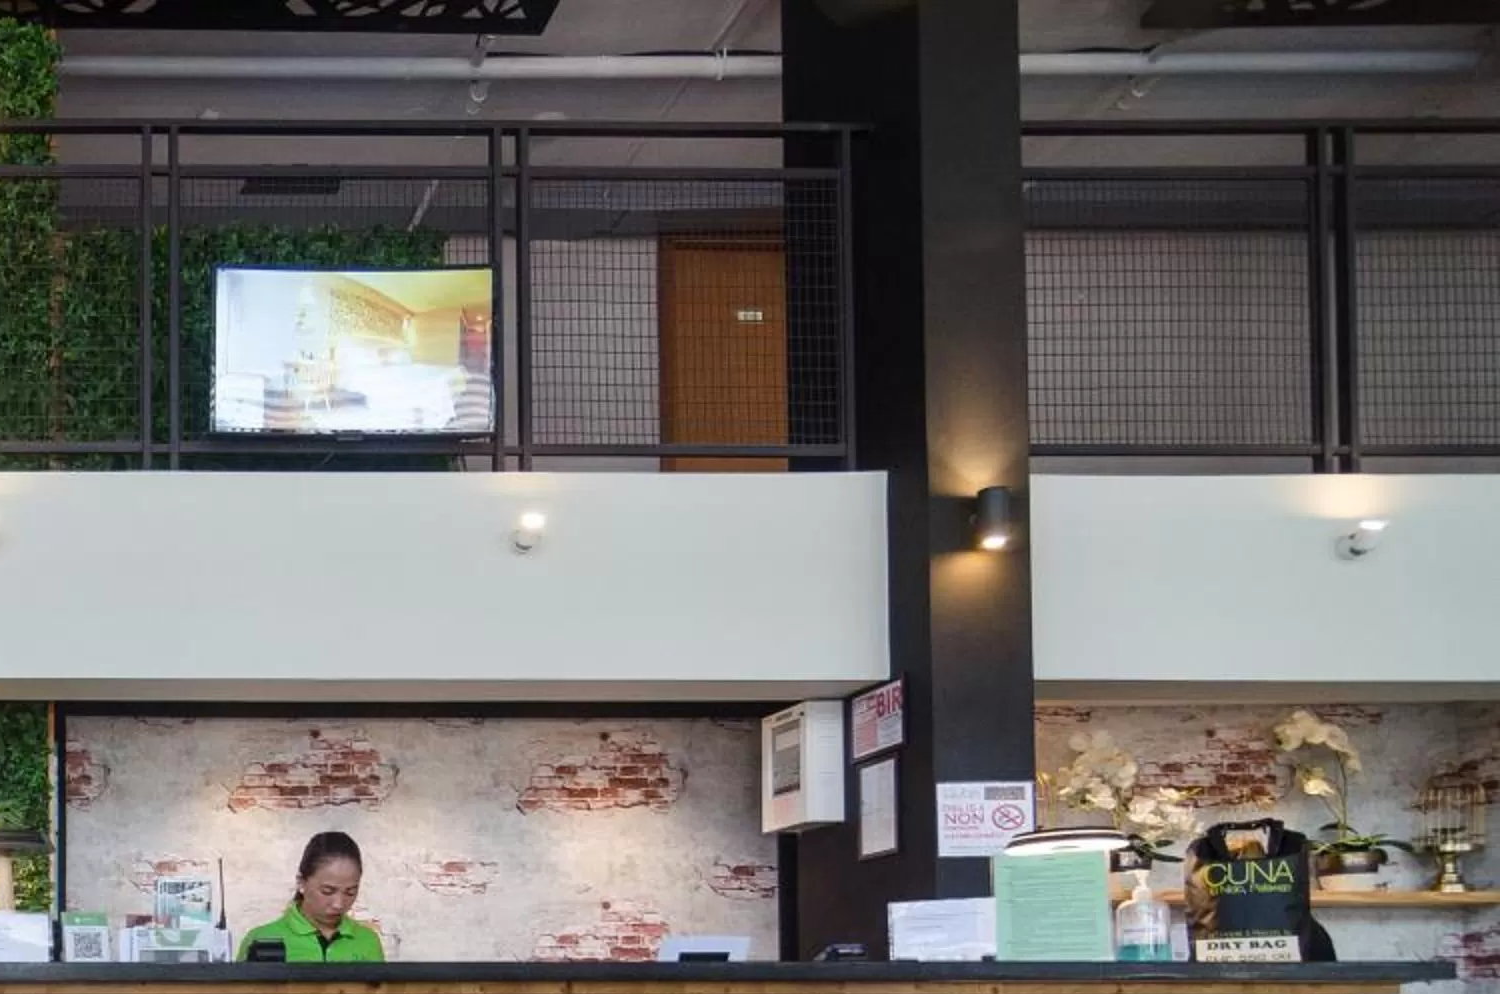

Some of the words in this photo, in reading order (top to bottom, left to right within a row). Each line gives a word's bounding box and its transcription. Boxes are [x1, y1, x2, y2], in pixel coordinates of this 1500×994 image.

[876, 688, 901, 717] BIR
[944, 812, 985, 825] NON
[1204, 860, 1294, 888] CUNA
[1206, 941, 1243, 951] DRY
[1249, 939, 1287, 949] BAG
